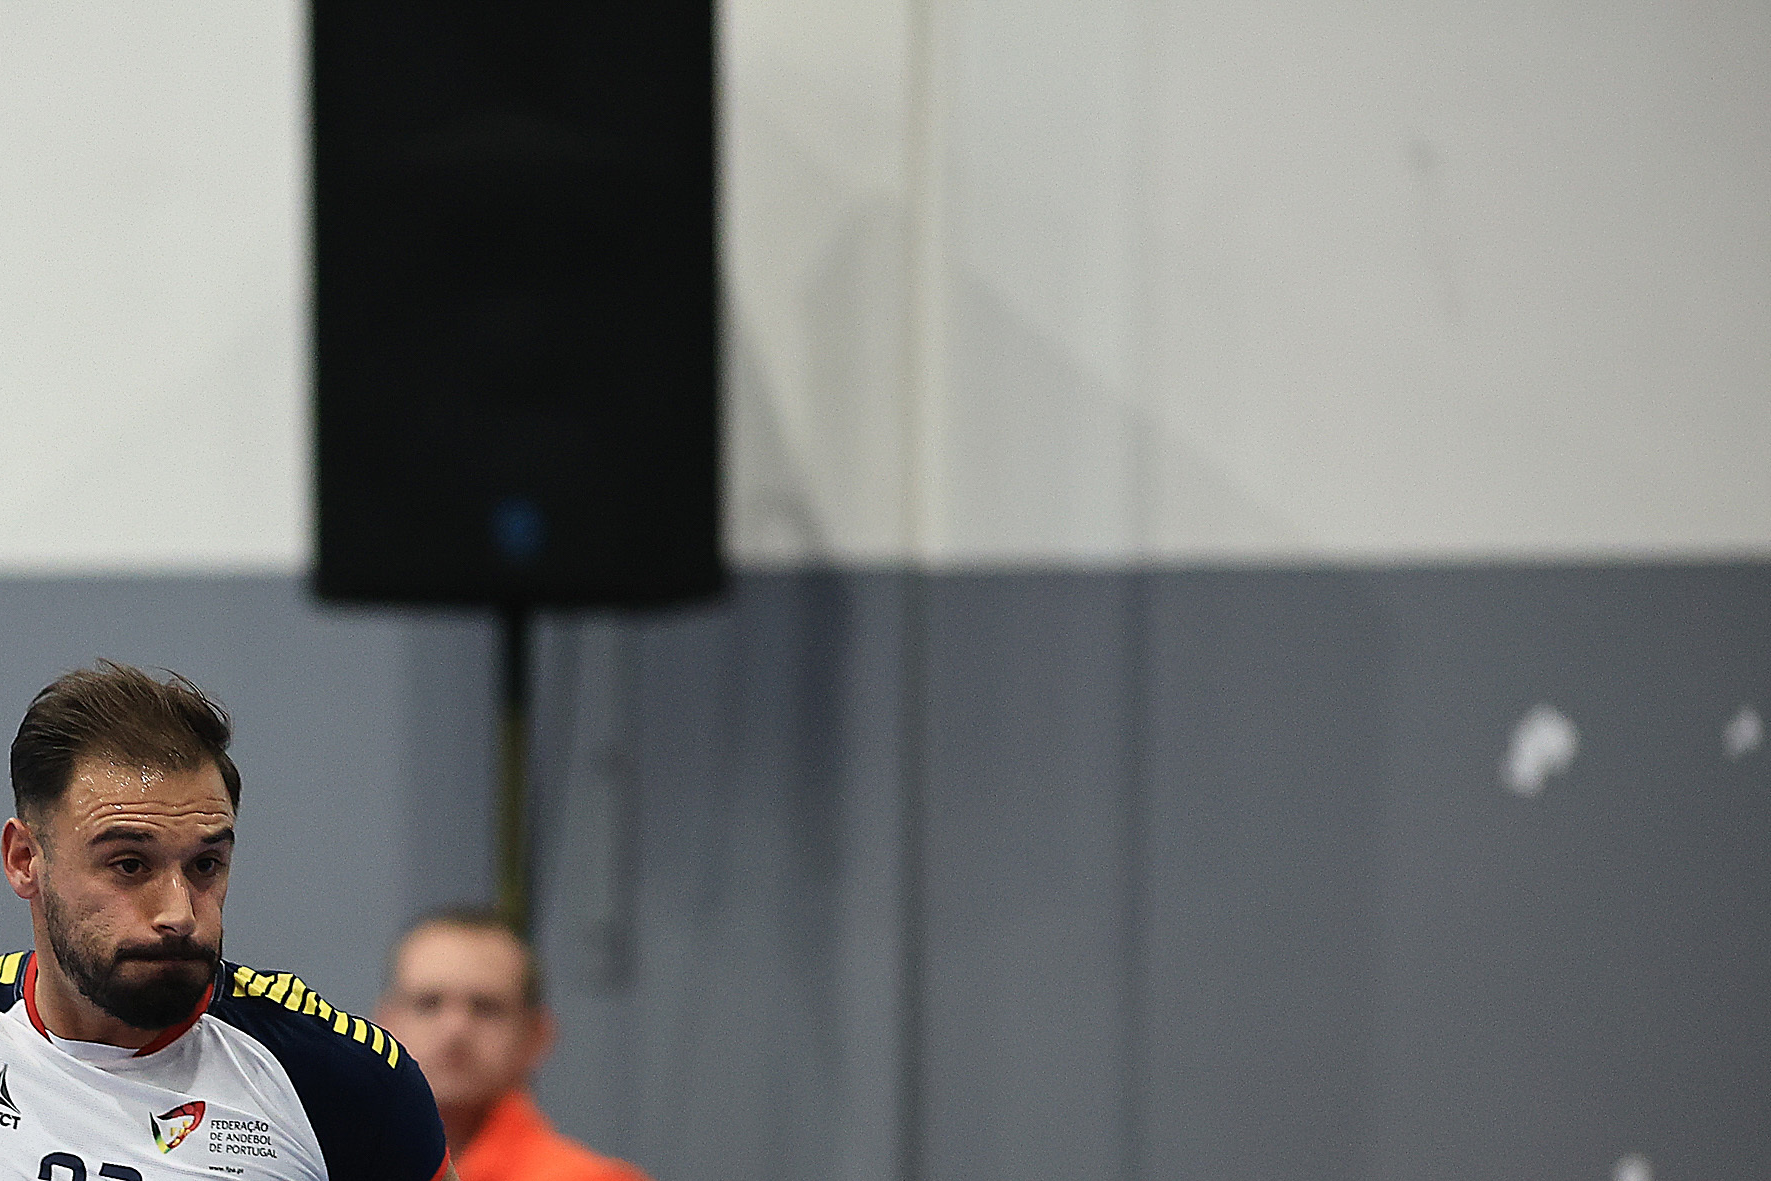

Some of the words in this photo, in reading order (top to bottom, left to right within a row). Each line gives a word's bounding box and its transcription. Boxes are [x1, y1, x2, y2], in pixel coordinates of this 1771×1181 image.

[210, 1119, 269, 1133] FEDERAÇÃO
[210, 1132, 223, 1142] DE
[226, 1133, 272, 1146] ANDEBOL
[209, 1143, 222, 1153] DE
[225, 1144, 278, 1159] PORTUGAL
